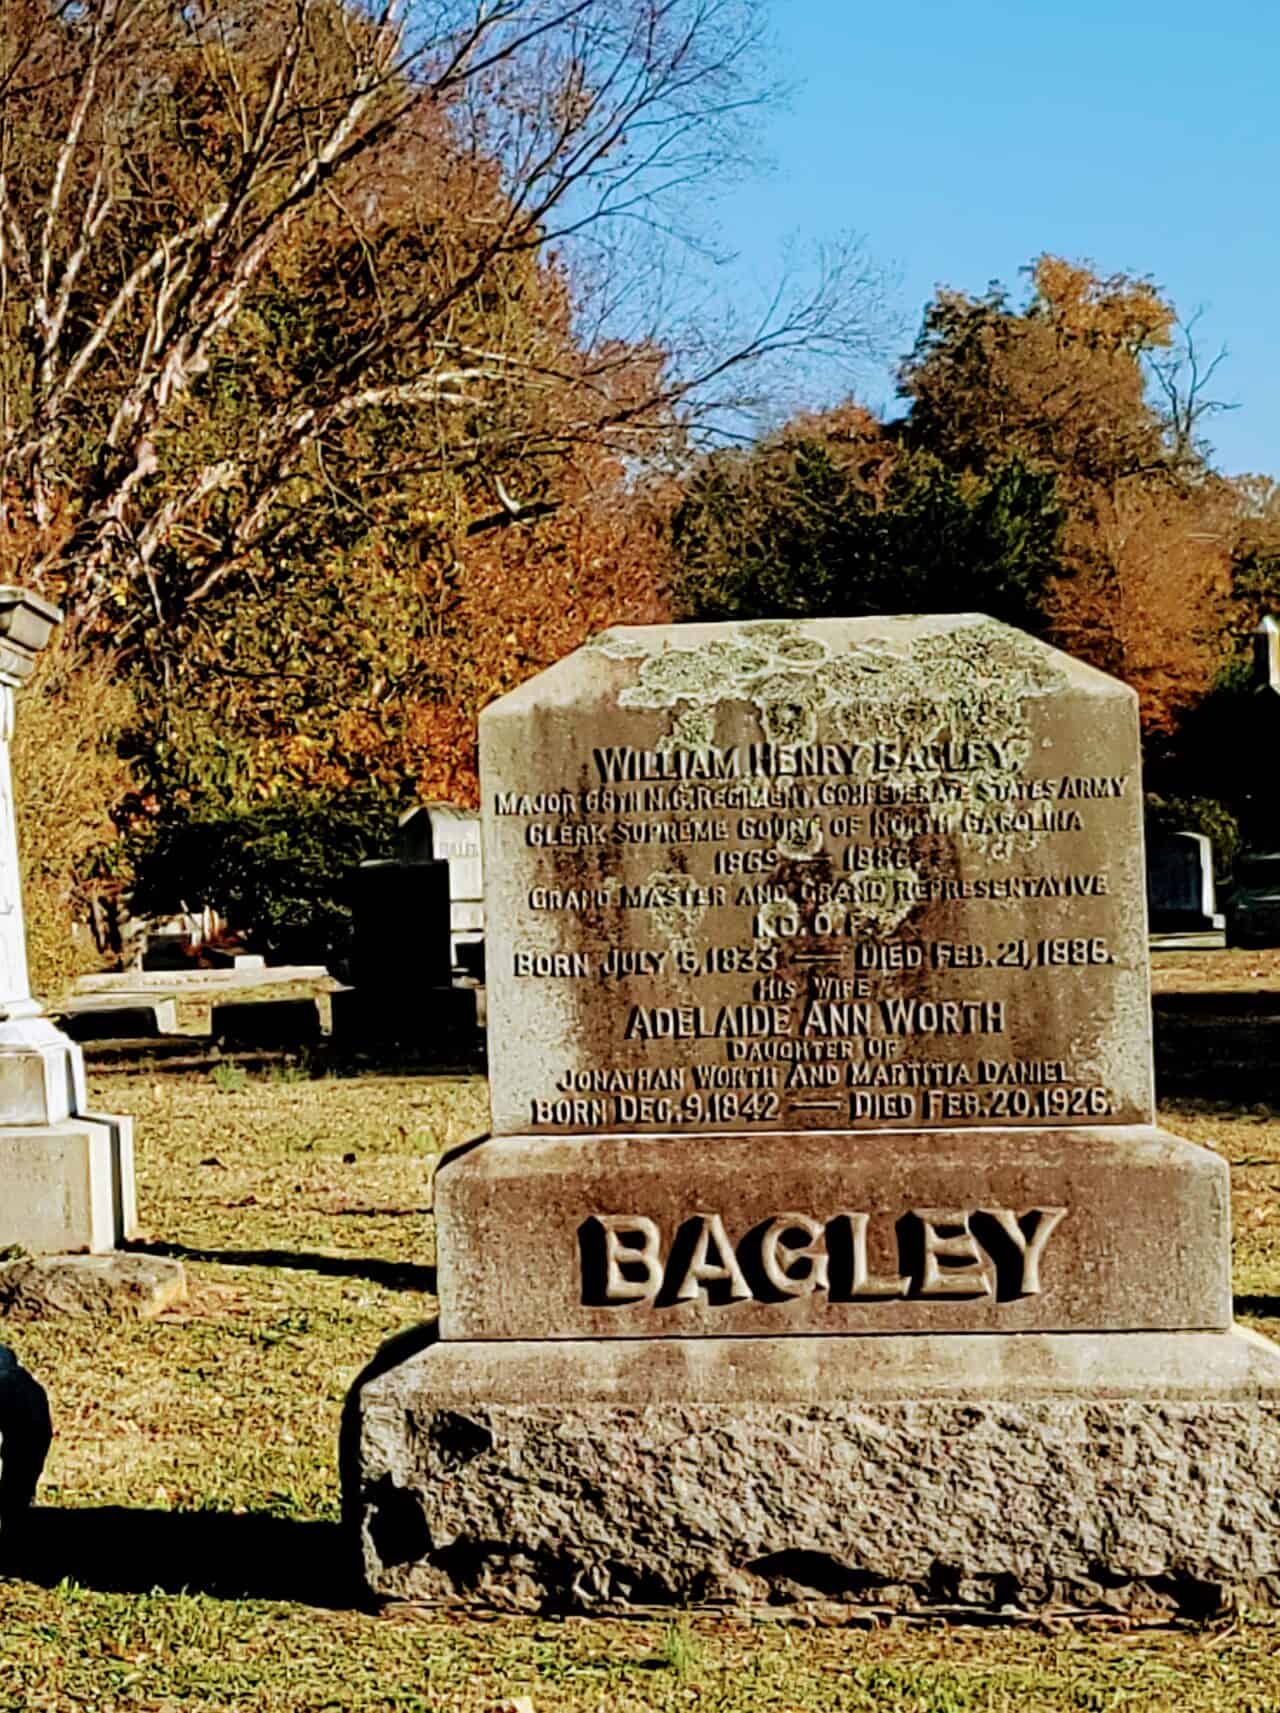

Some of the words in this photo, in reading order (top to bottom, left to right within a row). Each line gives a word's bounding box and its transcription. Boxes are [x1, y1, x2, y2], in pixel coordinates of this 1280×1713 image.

[595, 746, 739, 782] WILLIAM
[750, 743, 859, 777] HENRY
[496, 790, 576, 816] MAJOR
[822, 780, 969, 806] CONFEDERATE
[972, 777, 1056, 802] STATES
[1058, 775, 1128, 799] ARMY
[528, 822, 606, 847] CLERK
[613, 818, 728, 844] SUPREME
[738, 814, 819, 841] COURT
[831, 815, 864, 837] OF
[871, 810, 954, 836] NORTH
[963, 809, 1084, 834] CAROLINA
[715, 850, 778, 875] 1869
[529, 886, 610, 911] GRAND
[620, 884, 726, 908] MASTER
[736, 884, 787, 907] AND
[801, 879, 885, 904] GRAND
[892, 875, 1109, 901] REPRESENTATIVE
[514, 951, 590, 977] BORN
[601, 949, 666, 976] JULY
[856, 942, 922, 970] DIED
[753, 977, 796, 1001] HIS
[810, 977, 870, 1000] WIFE
[626, 1005, 793, 1040] ADELAIDE
[803, 1000, 871, 1037] ANN
[878, 999, 1007, 1035] WORTH
[727, 1039, 853, 1061] DAUGHTER
[862, 1038, 900, 1061] OF
[556, 1067, 685, 1093] JONATHAN
[692, 1064, 777, 1091] WORTH
[786, 1063, 841, 1089] AND
[847, 1061, 970, 1089] MARTITIA
[979, 1059, 1074, 1085] DANIEL
[532, 1097, 607, 1125] BORN
[852, 1091, 917, 1121] DIED
[580, 1207, 1068, 1306] BAGLEY
